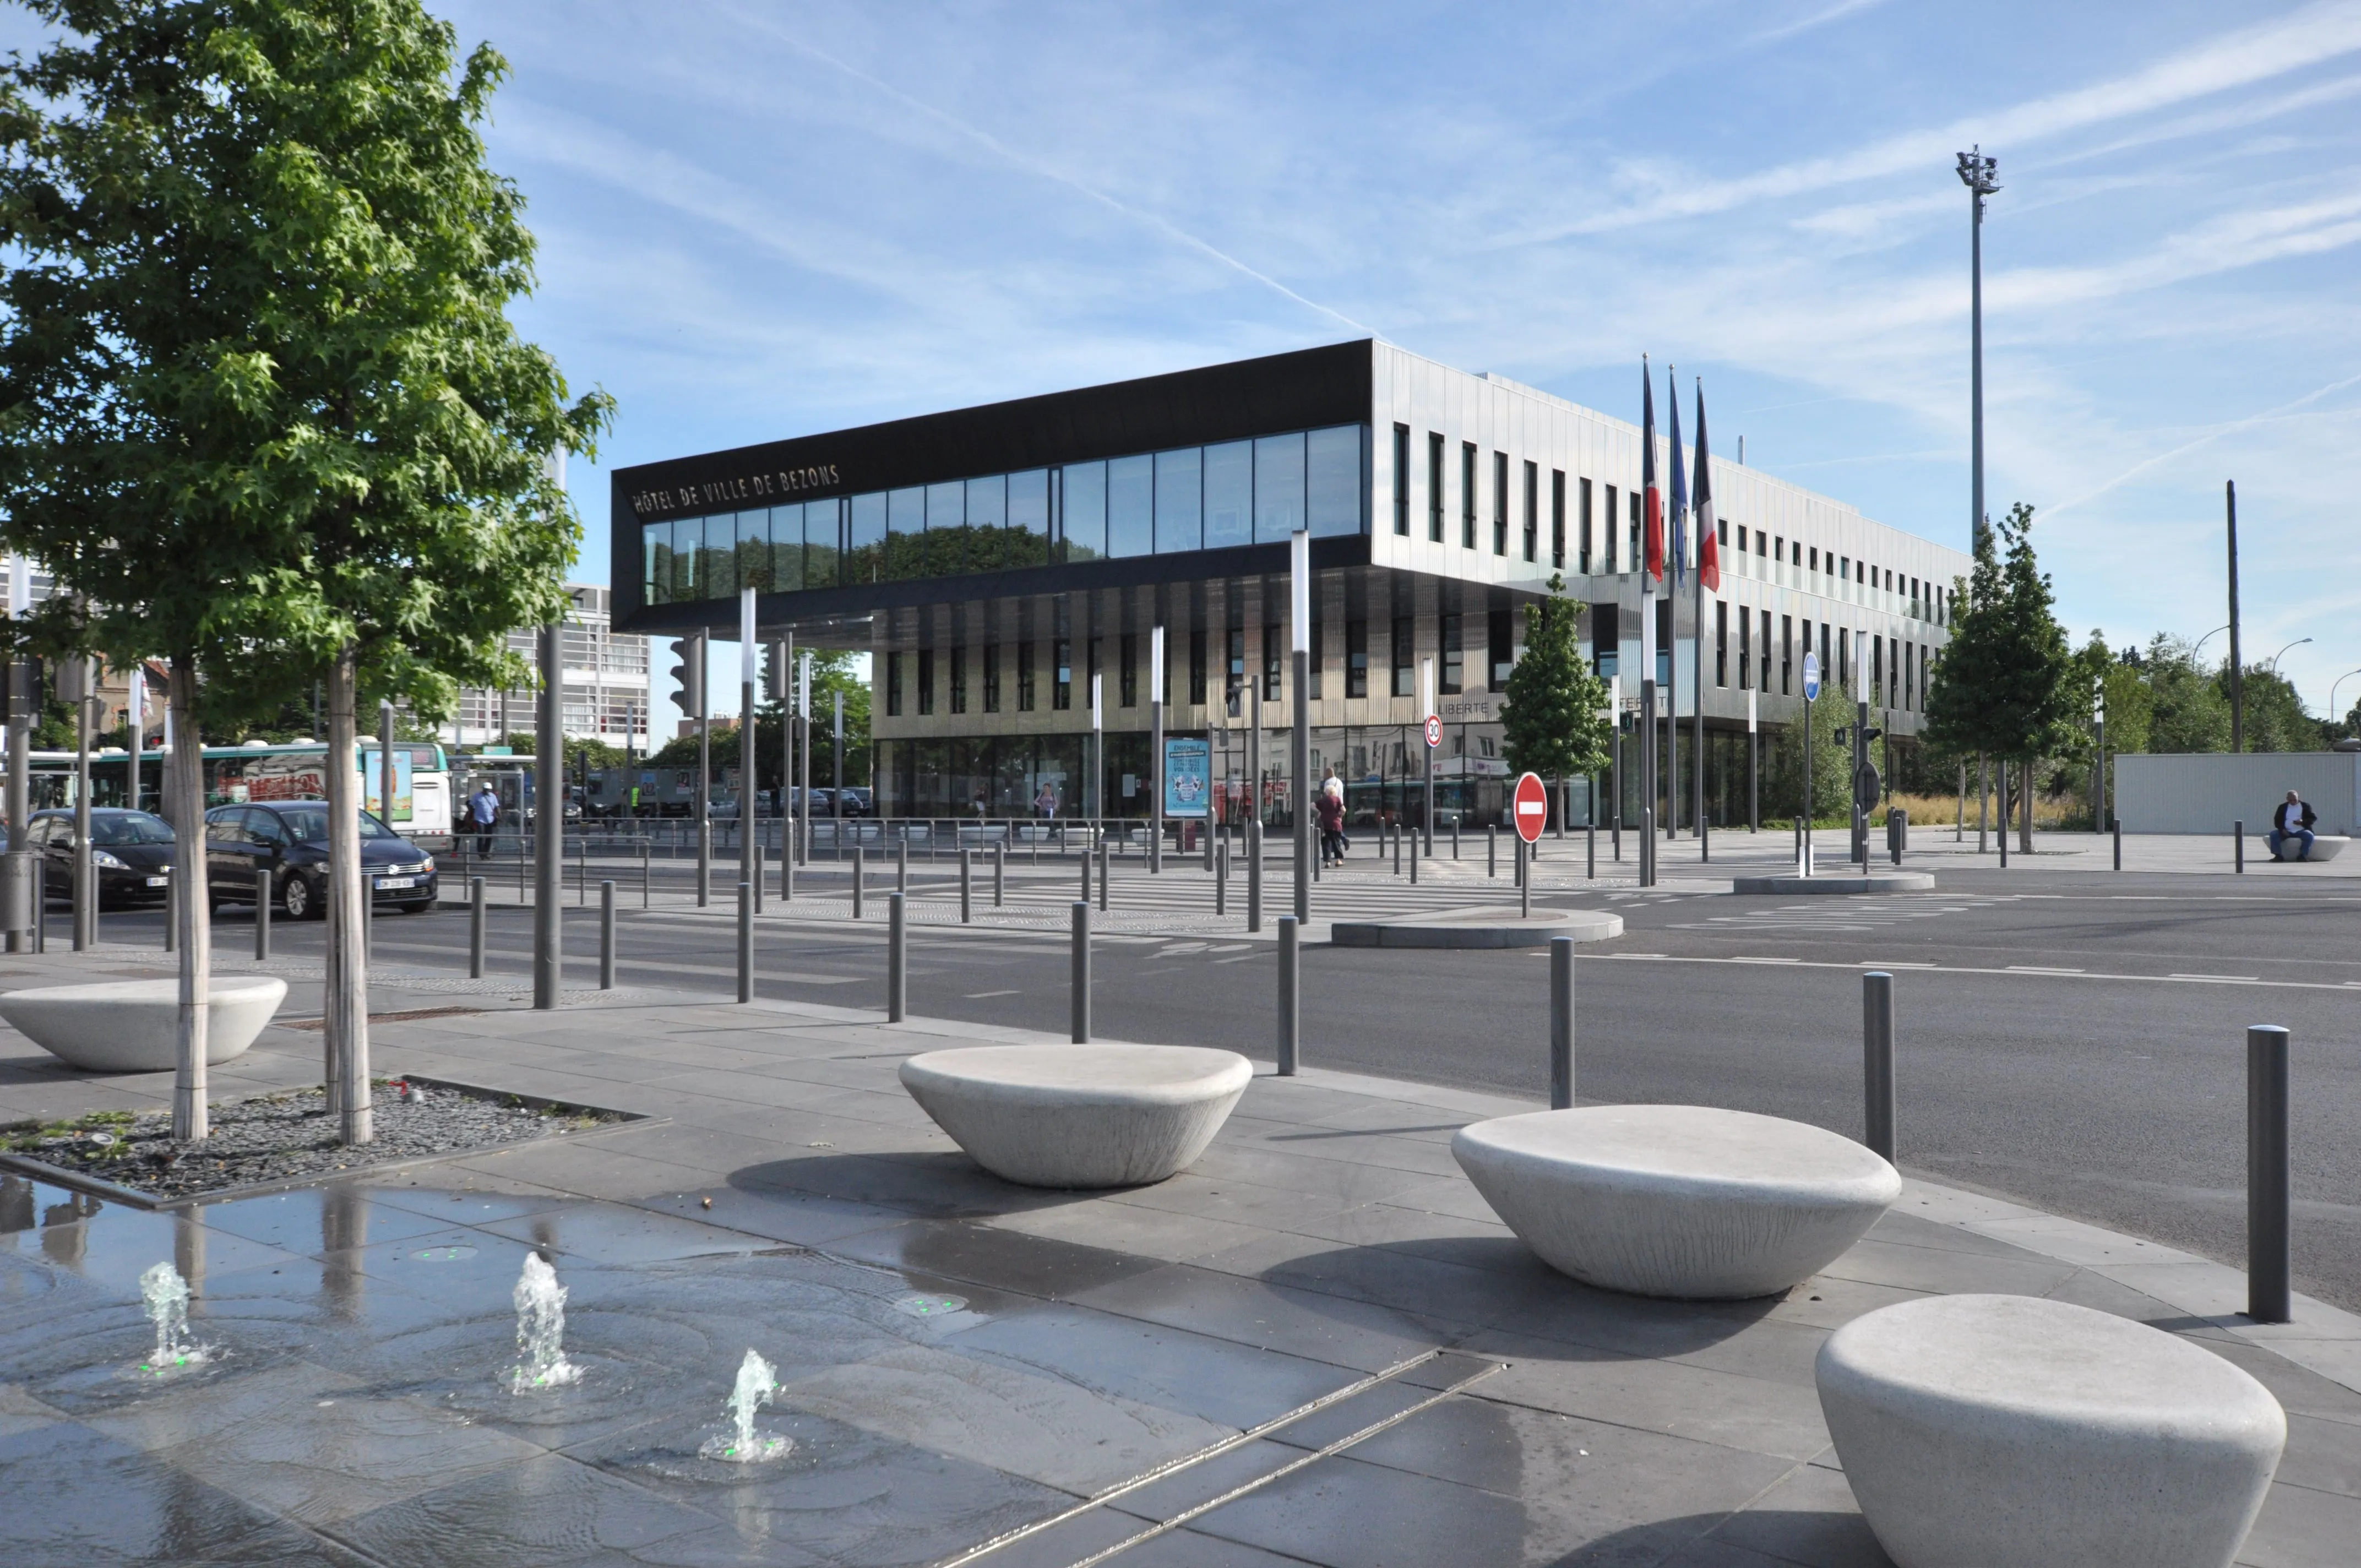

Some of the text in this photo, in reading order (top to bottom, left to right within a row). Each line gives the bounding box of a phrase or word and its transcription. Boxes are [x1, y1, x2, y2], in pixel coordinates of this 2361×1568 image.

[633, 464, 839, 513] HÔTEL DE VILLE DE BEZONS
[1438, 703, 1488, 715] LIBERTE
[1429, 724, 1439, 737] 30
